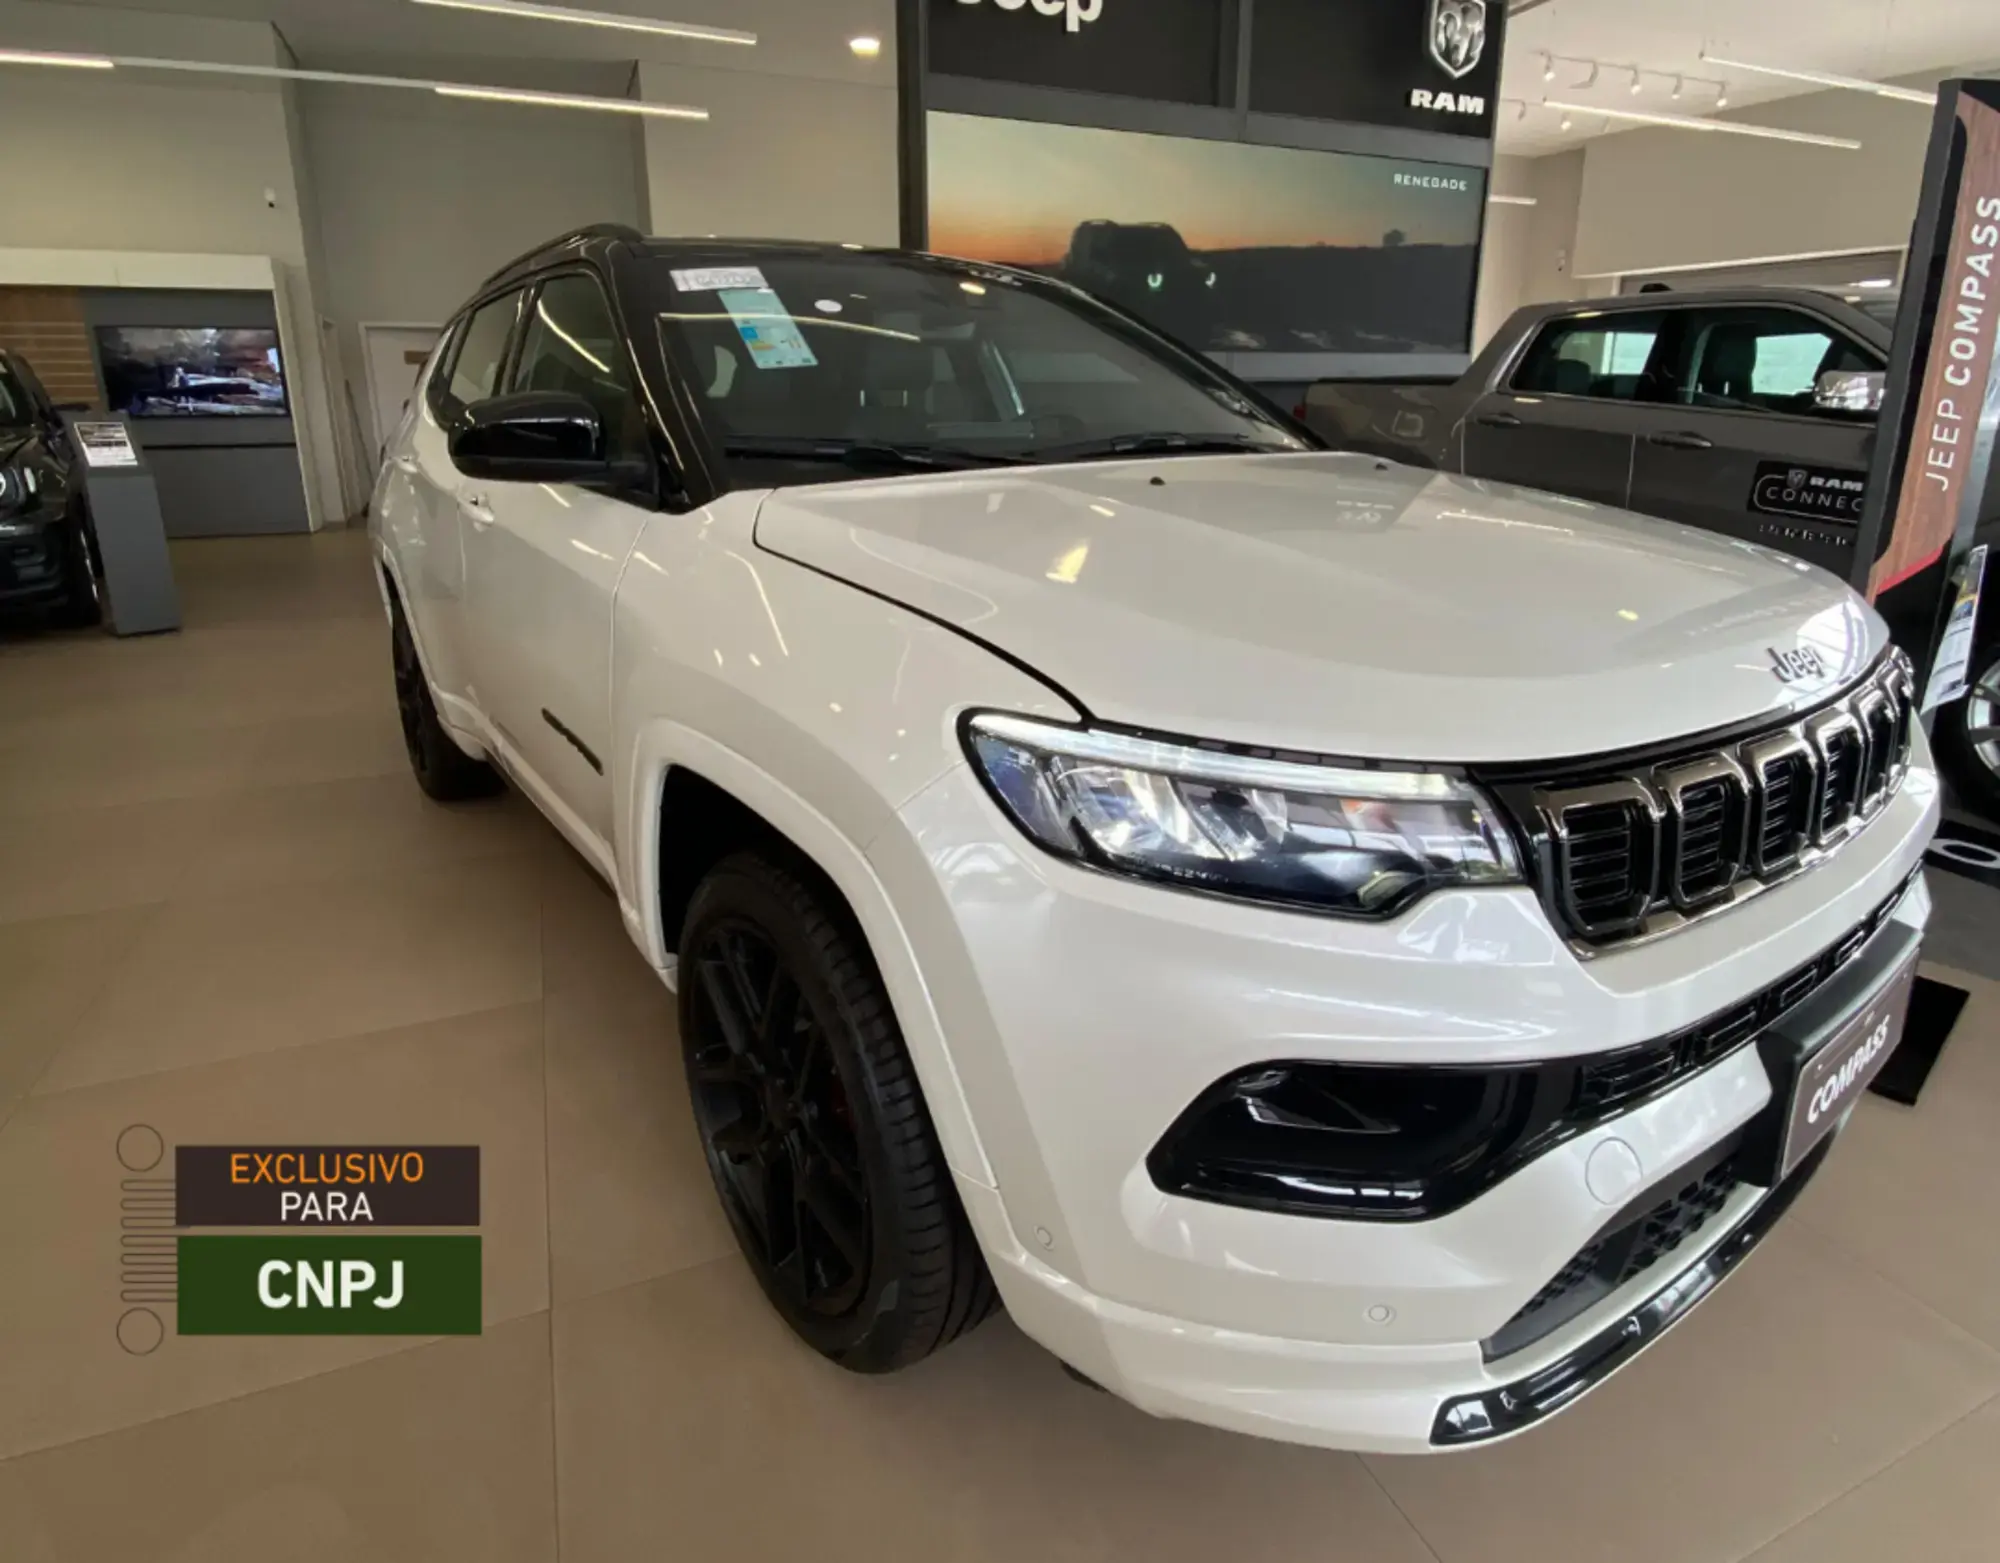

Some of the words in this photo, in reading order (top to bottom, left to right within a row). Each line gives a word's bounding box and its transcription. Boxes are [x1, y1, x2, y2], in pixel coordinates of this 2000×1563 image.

[1410, 88, 1485, 115] RAM
[1393, 172, 1468, 191] RENEGADE
[1926, 398, 1962, 491] JEEP
[1944, 196, 2000, 386] COMPASS
[1809, 476, 1864, 491] RAM
[1766, 486, 1864, 512] CONNEC
[1765, 645, 1825, 683] Jeep
[1807, 1013, 1891, 1124] COMPASS
